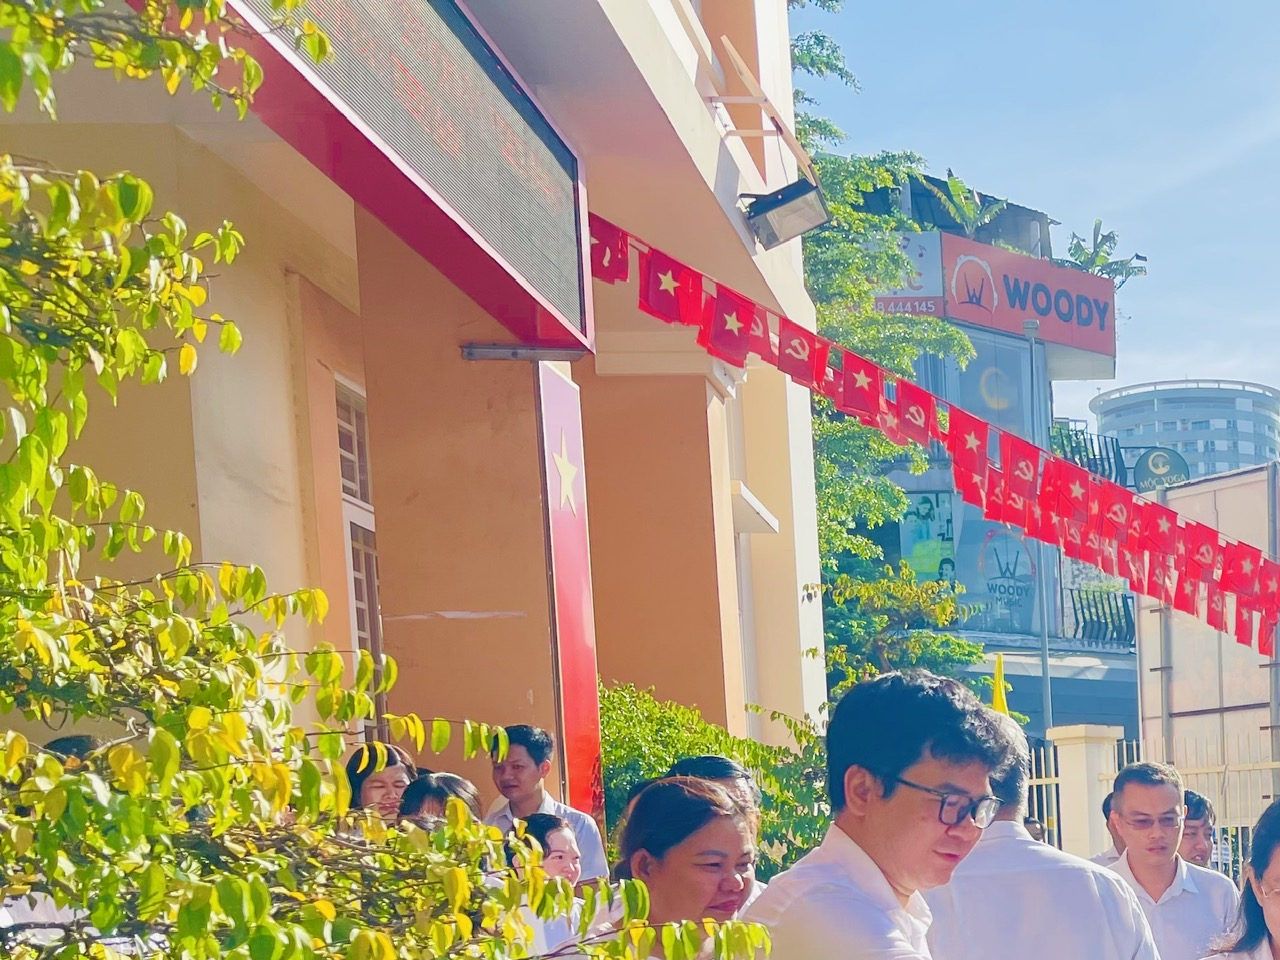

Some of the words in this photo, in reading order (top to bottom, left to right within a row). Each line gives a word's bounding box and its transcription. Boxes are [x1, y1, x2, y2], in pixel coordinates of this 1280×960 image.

[888, 301, 912, 313] 444
[914, 300, 935, 313] 145
[1003, 274, 1110, 332] WOODY
[1161, 473, 1187, 486] YOGA
[986, 582, 1030, 597] WOODY
[995, 596, 1023, 607] MUSIC
